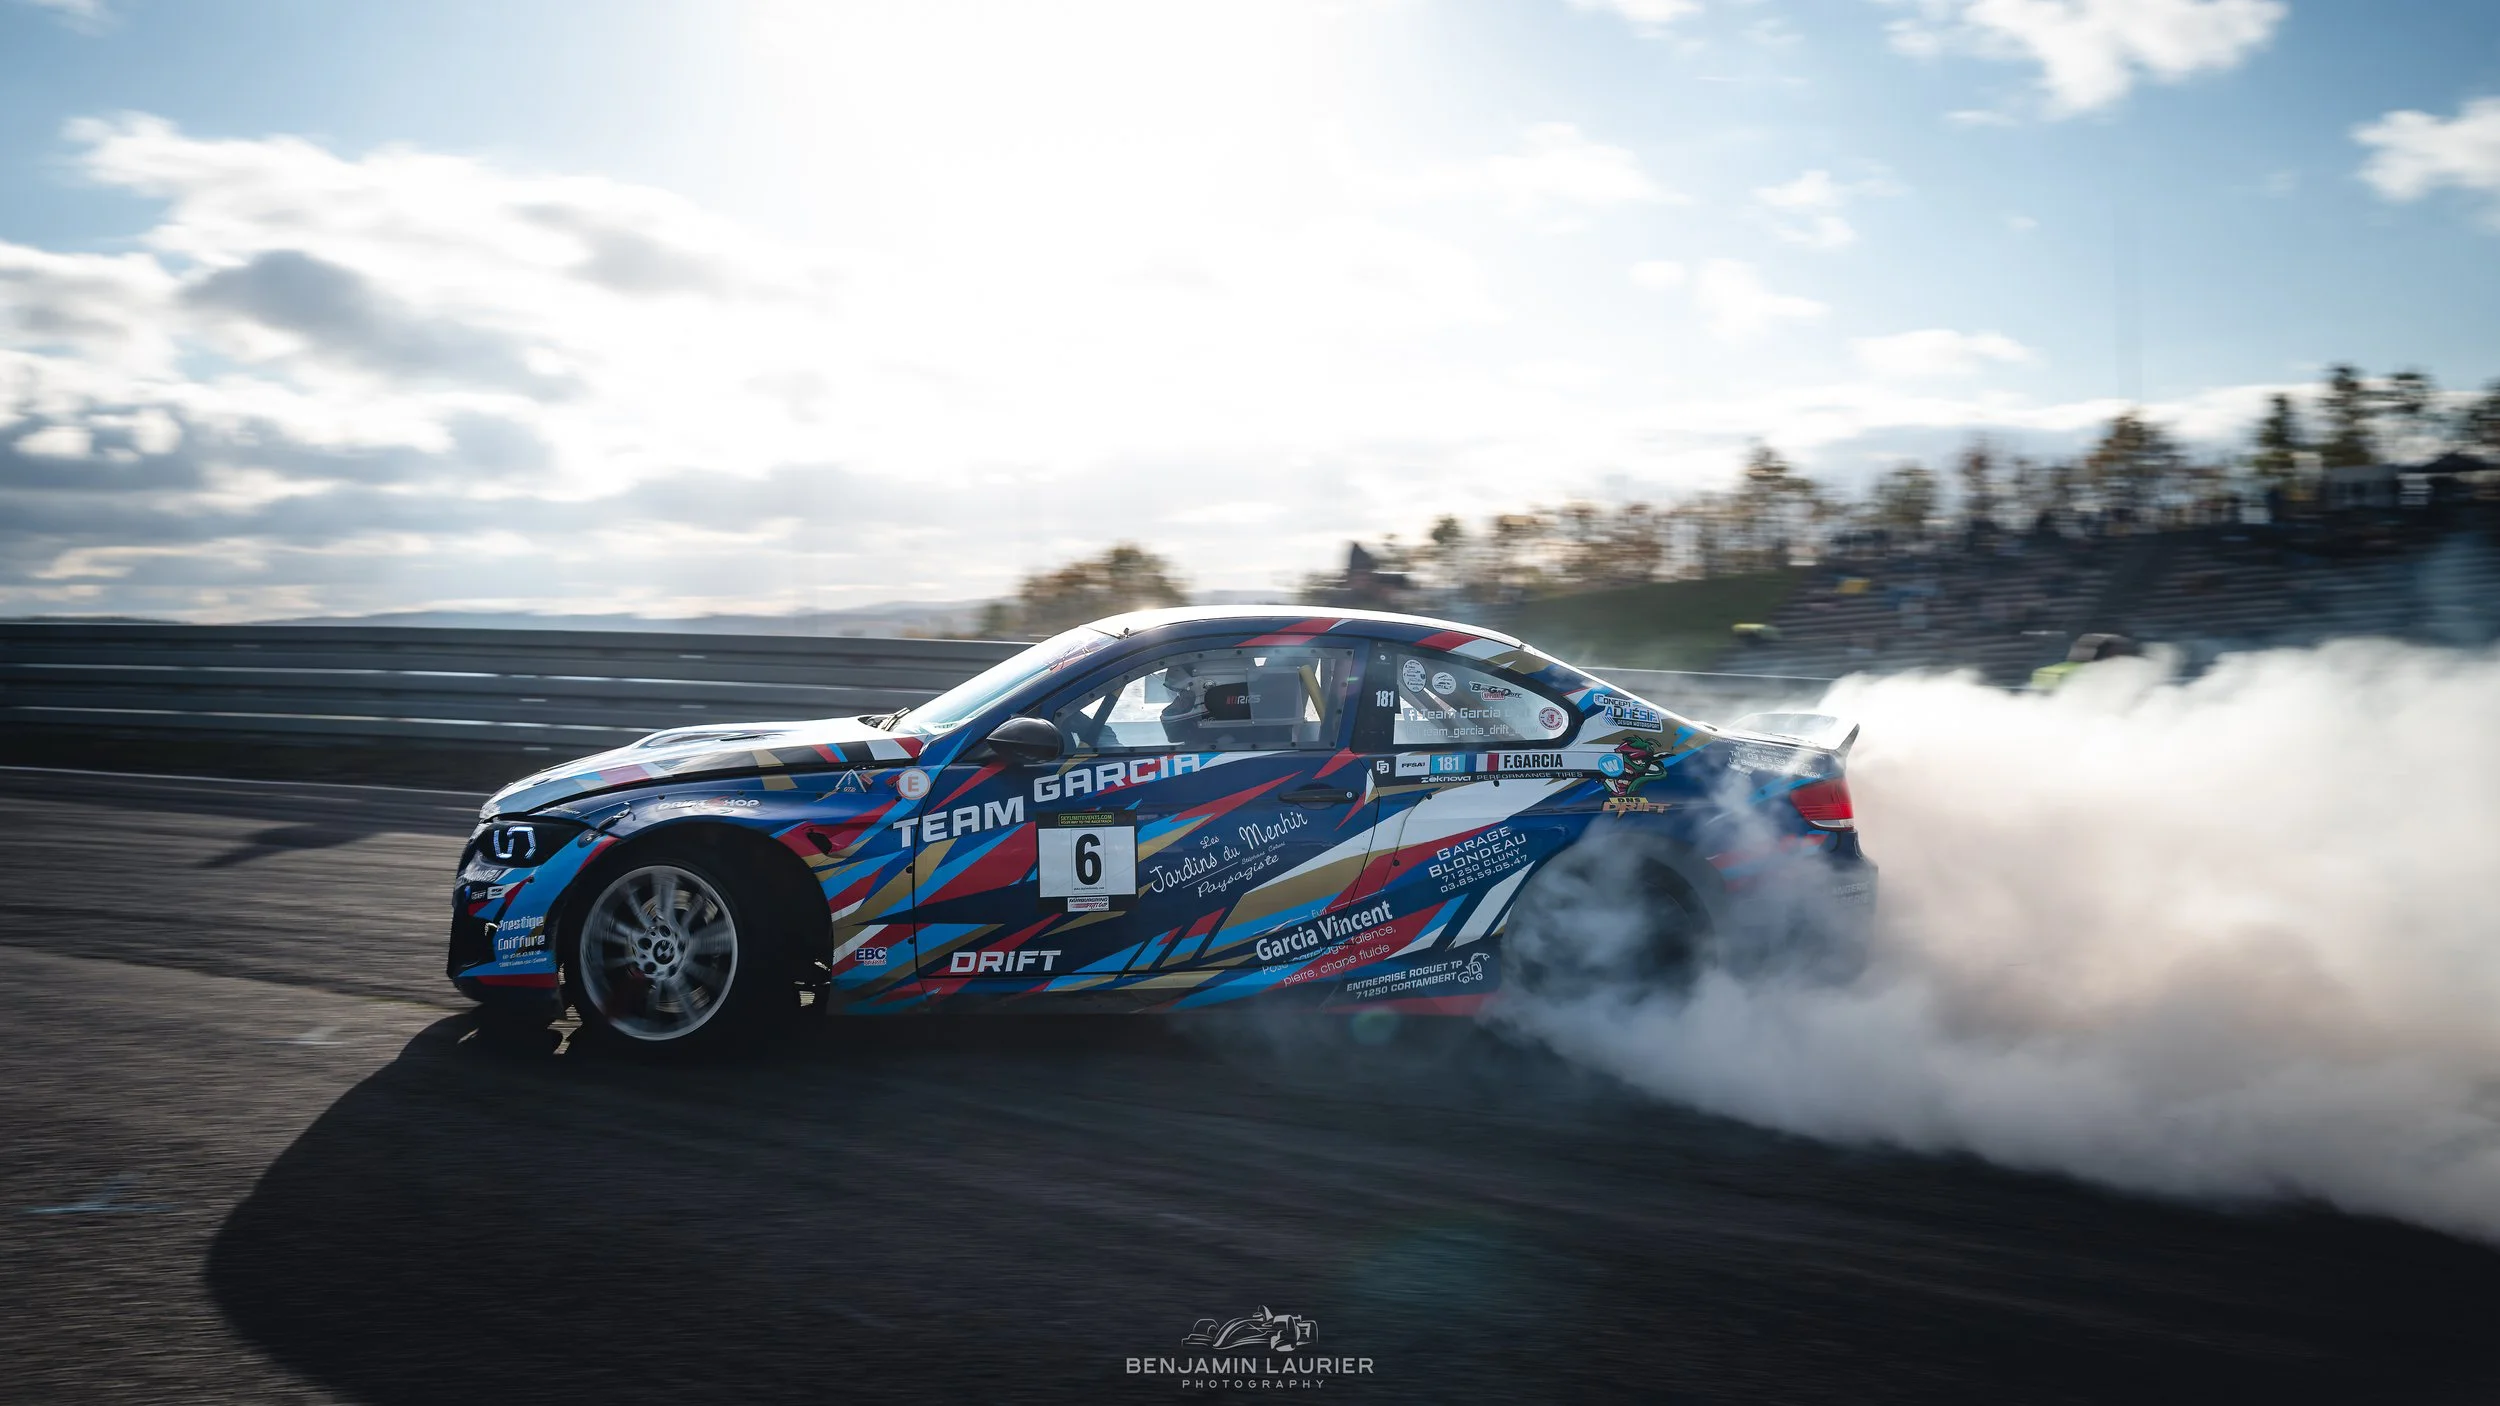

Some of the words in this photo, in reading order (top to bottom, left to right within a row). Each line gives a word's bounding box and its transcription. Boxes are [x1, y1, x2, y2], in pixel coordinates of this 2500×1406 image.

[1375, 690, 1395, 707] 181
[1597, 694, 1632, 707] CONCEPT
[1421, 707, 1456, 720] Team
[1459, 705, 1501, 719] Garcia
[1438, 756, 1460, 772] 181
[1503, 753, 1564, 769] F.GARCIA
[907, 776, 921, 793] E
[1476, 771, 1552, 782] PERFORMANCE
[893, 795, 1025, 849] TEAM
[1033, 752, 1201, 803] GARCIA
[1602, 801, 1672, 817] DRIFT
[1200, 834, 1220, 849] Les
[1436, 826, 1511, 861] GARAGE
[1075, 833, 1102, 886] 6
[1149, 852, 1218, 893] Jardins
[1223, 845, 1241, 861] du
[1238, 811, 1308, 850] Menhir
[1428, 833, 1527, 878] BLONDEAU
[1440, 854, 1528, 893] 03.85.59.05.47
[1441, 863, 1480, 883] 71250
[1483, 847, 1520, 867] CLUNY
[1197, 853, 1280, 898] Paysagiste
[497, 915, 544, 932] Prestige
[1255, 925, 1319, 961] Garcia
[1317, 899, 1393, 941] Vincent
[497, 934, 546, 951] Coiffure
[855, 947, 887, 961] EBC
[950, 949, 1062, 973] DRIFT
[1346, 970, 1407, 992] ENTREPRISE
[1450, 959, 1463, 969] TP
[1356, 985, 1388, 1000] 71250
[1390, 971, 1457, 993] CORTAMBERT
